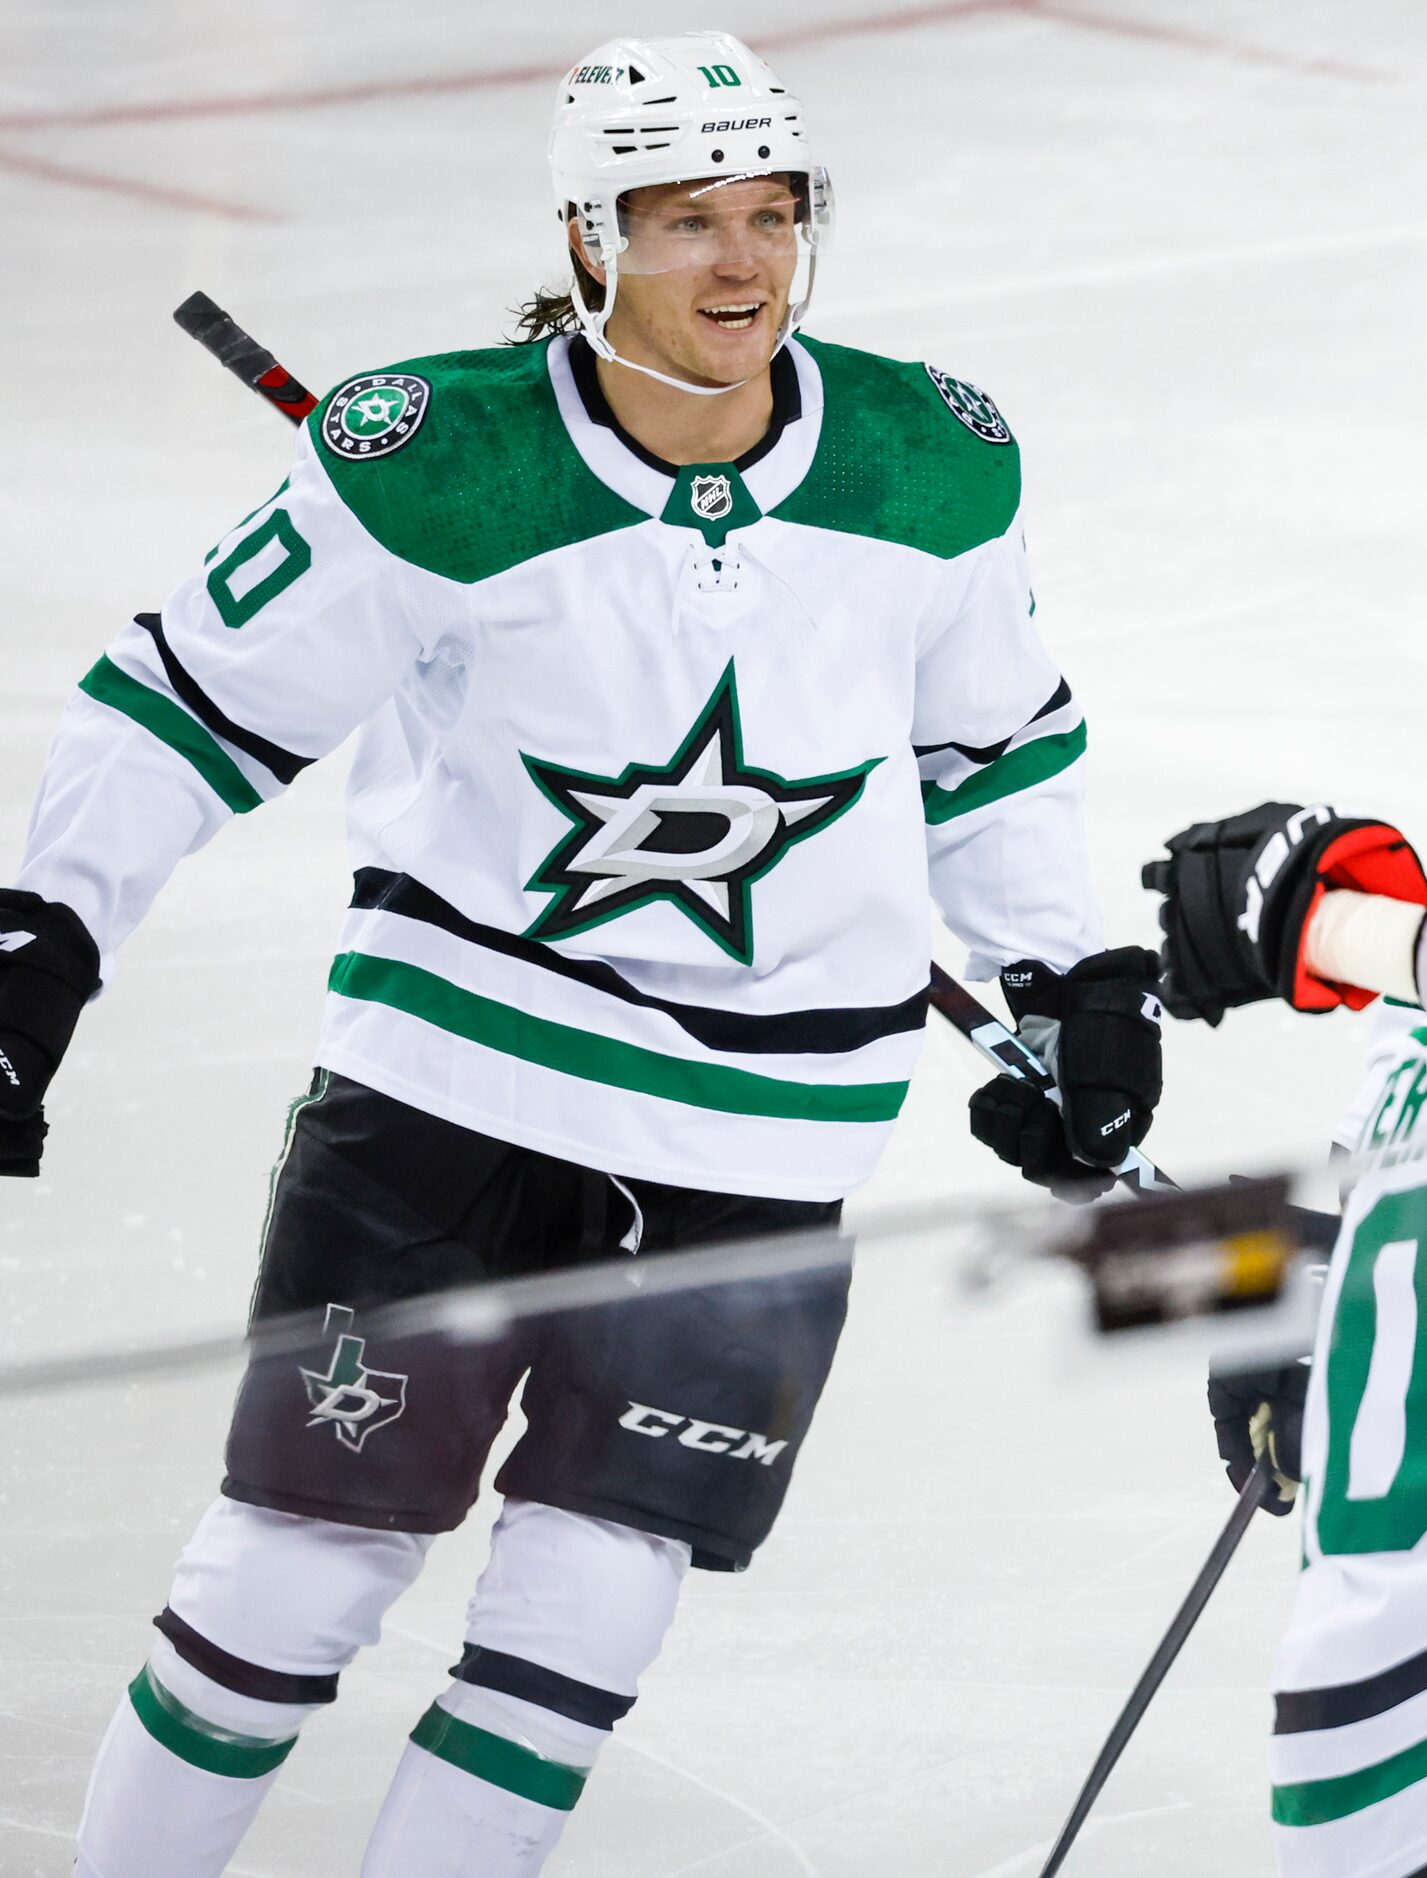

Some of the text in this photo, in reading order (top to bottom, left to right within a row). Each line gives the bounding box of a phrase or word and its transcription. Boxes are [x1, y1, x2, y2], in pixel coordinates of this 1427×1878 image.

[697, 64, 742, 88] 10
[329, 396, 372, 453] STARS
[371, 378, 423, 435] DALLAS
[700, 485, 723, 511] NHL
[203, 471, 312, 630] 0
[1003, 971, 1033, 982] CCM
[617, 1400, 789, 1467] CCM
